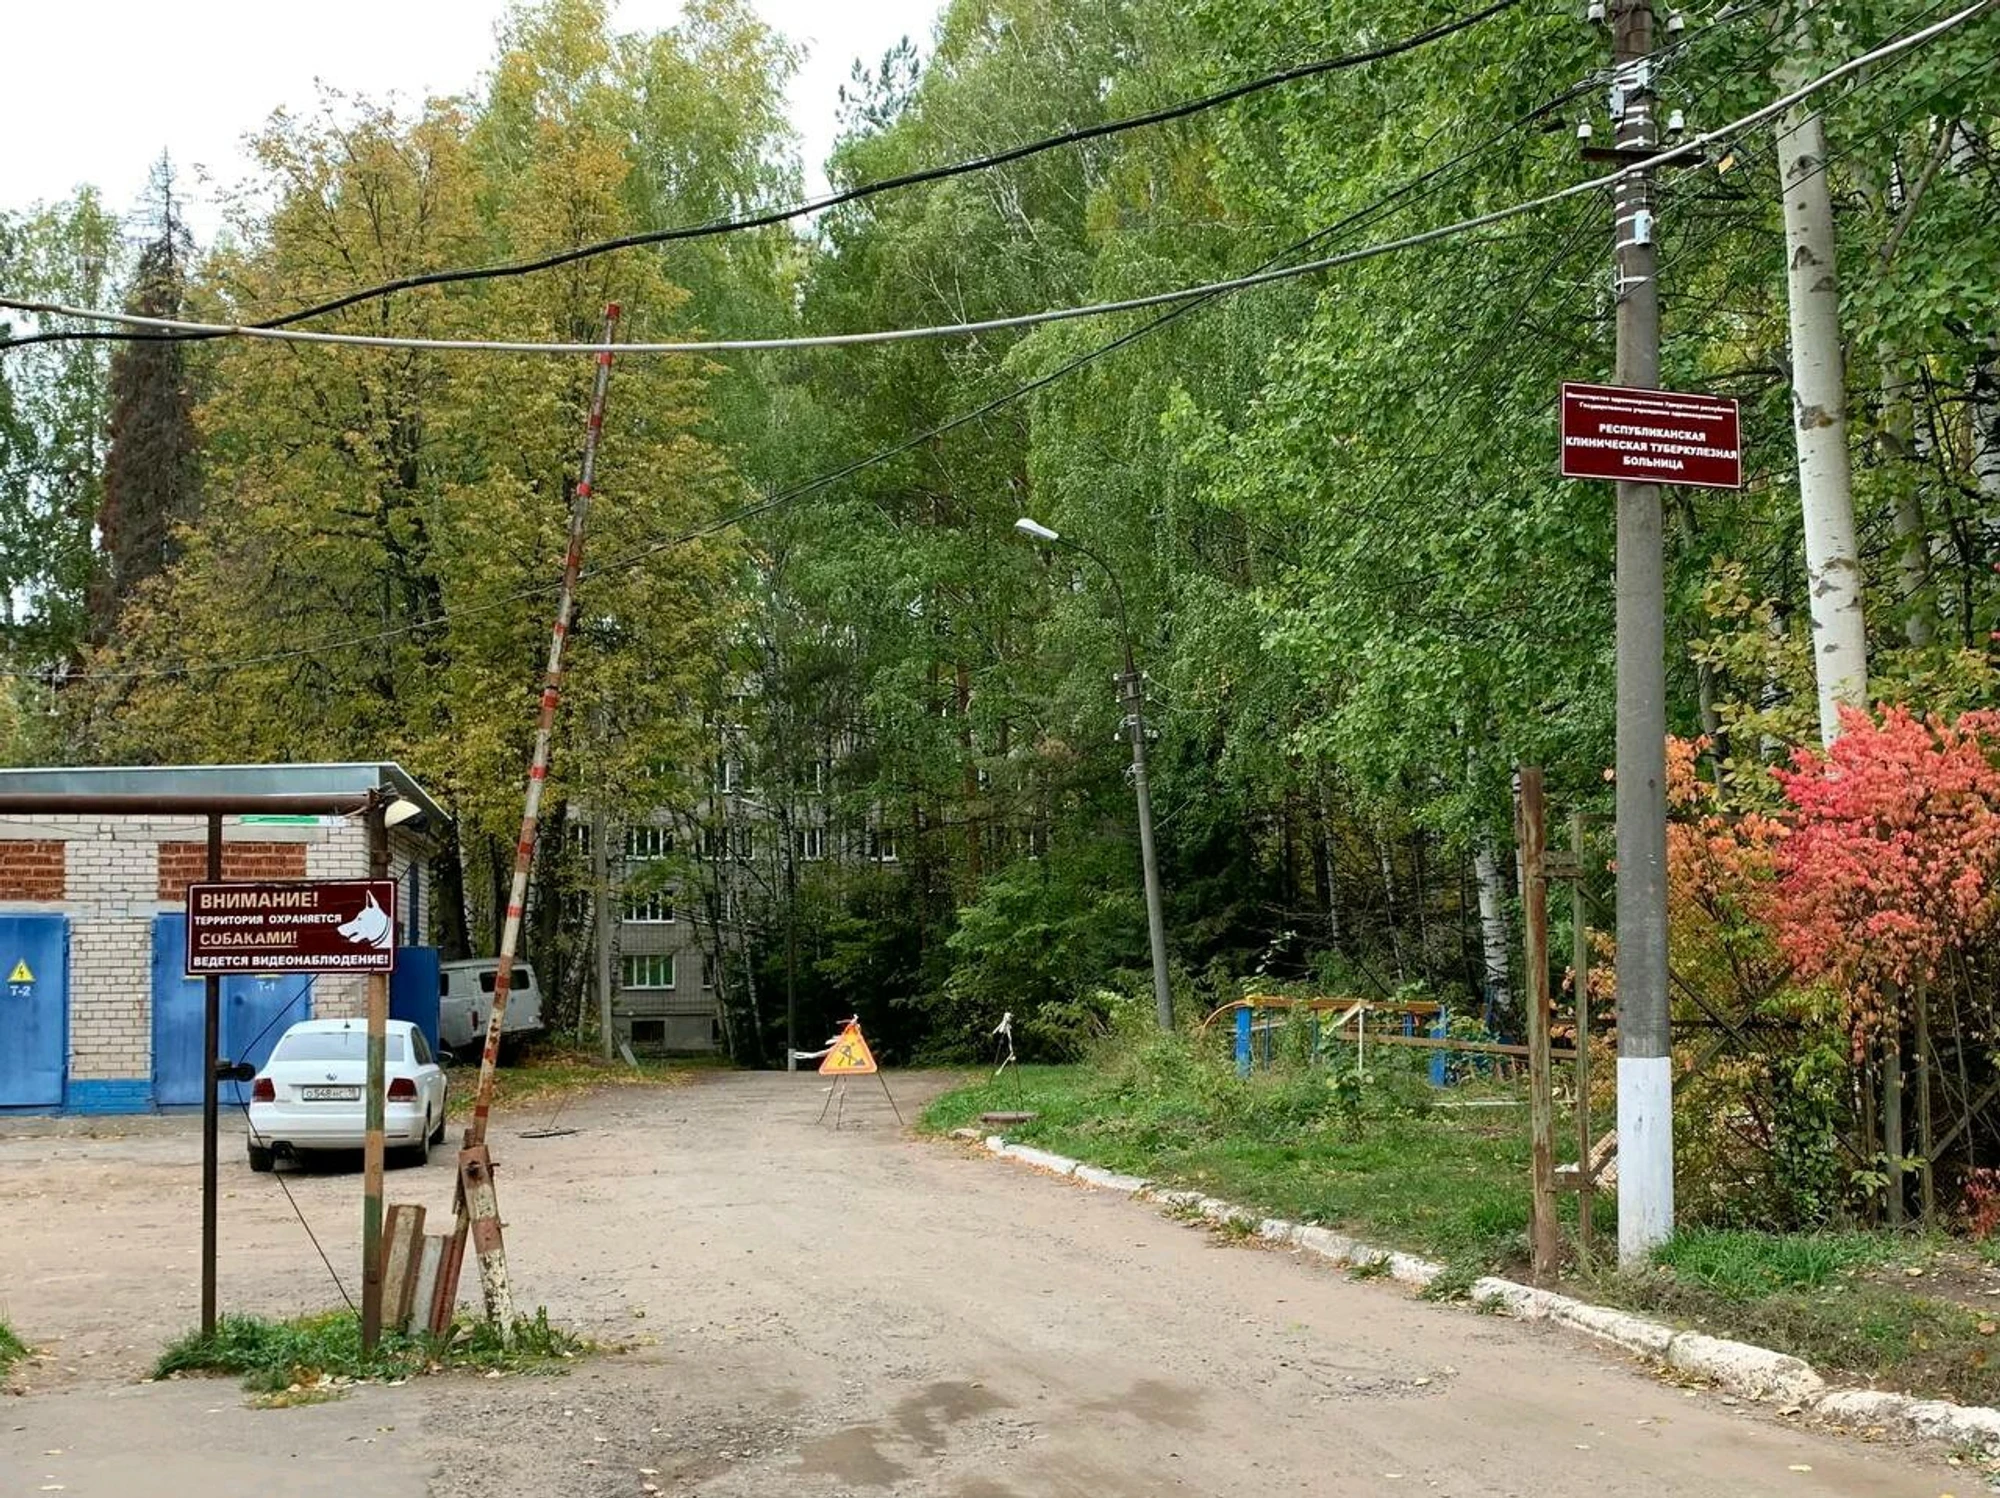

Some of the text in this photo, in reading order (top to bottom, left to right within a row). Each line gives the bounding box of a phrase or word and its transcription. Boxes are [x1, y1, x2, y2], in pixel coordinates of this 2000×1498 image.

[1599, 424, 1706, 442] РЕСПУБЛИКАНСКАЯ
[1565, 437, 1738, 460] КЛИНИЧЕСКАЯ ТУБЕРКУЛЕЗНАЯ
[1623, 455, 1684, 470] БОЛЬНИЦА
[200, 892, 319, 909] ВНИМАНИЕ!
[194, 914, 342, 925] ТЕРРИТОРИЯ ОХРАНЯЕТСЯ
[199, 931, 298, 945] СОБАКАМИ!
[193, 954, 389, 967] ВЕДЕТСЯ ВИДЕОНАБЛЮДЕНИЕ!
[9, 985, 31, 997] Т-2
